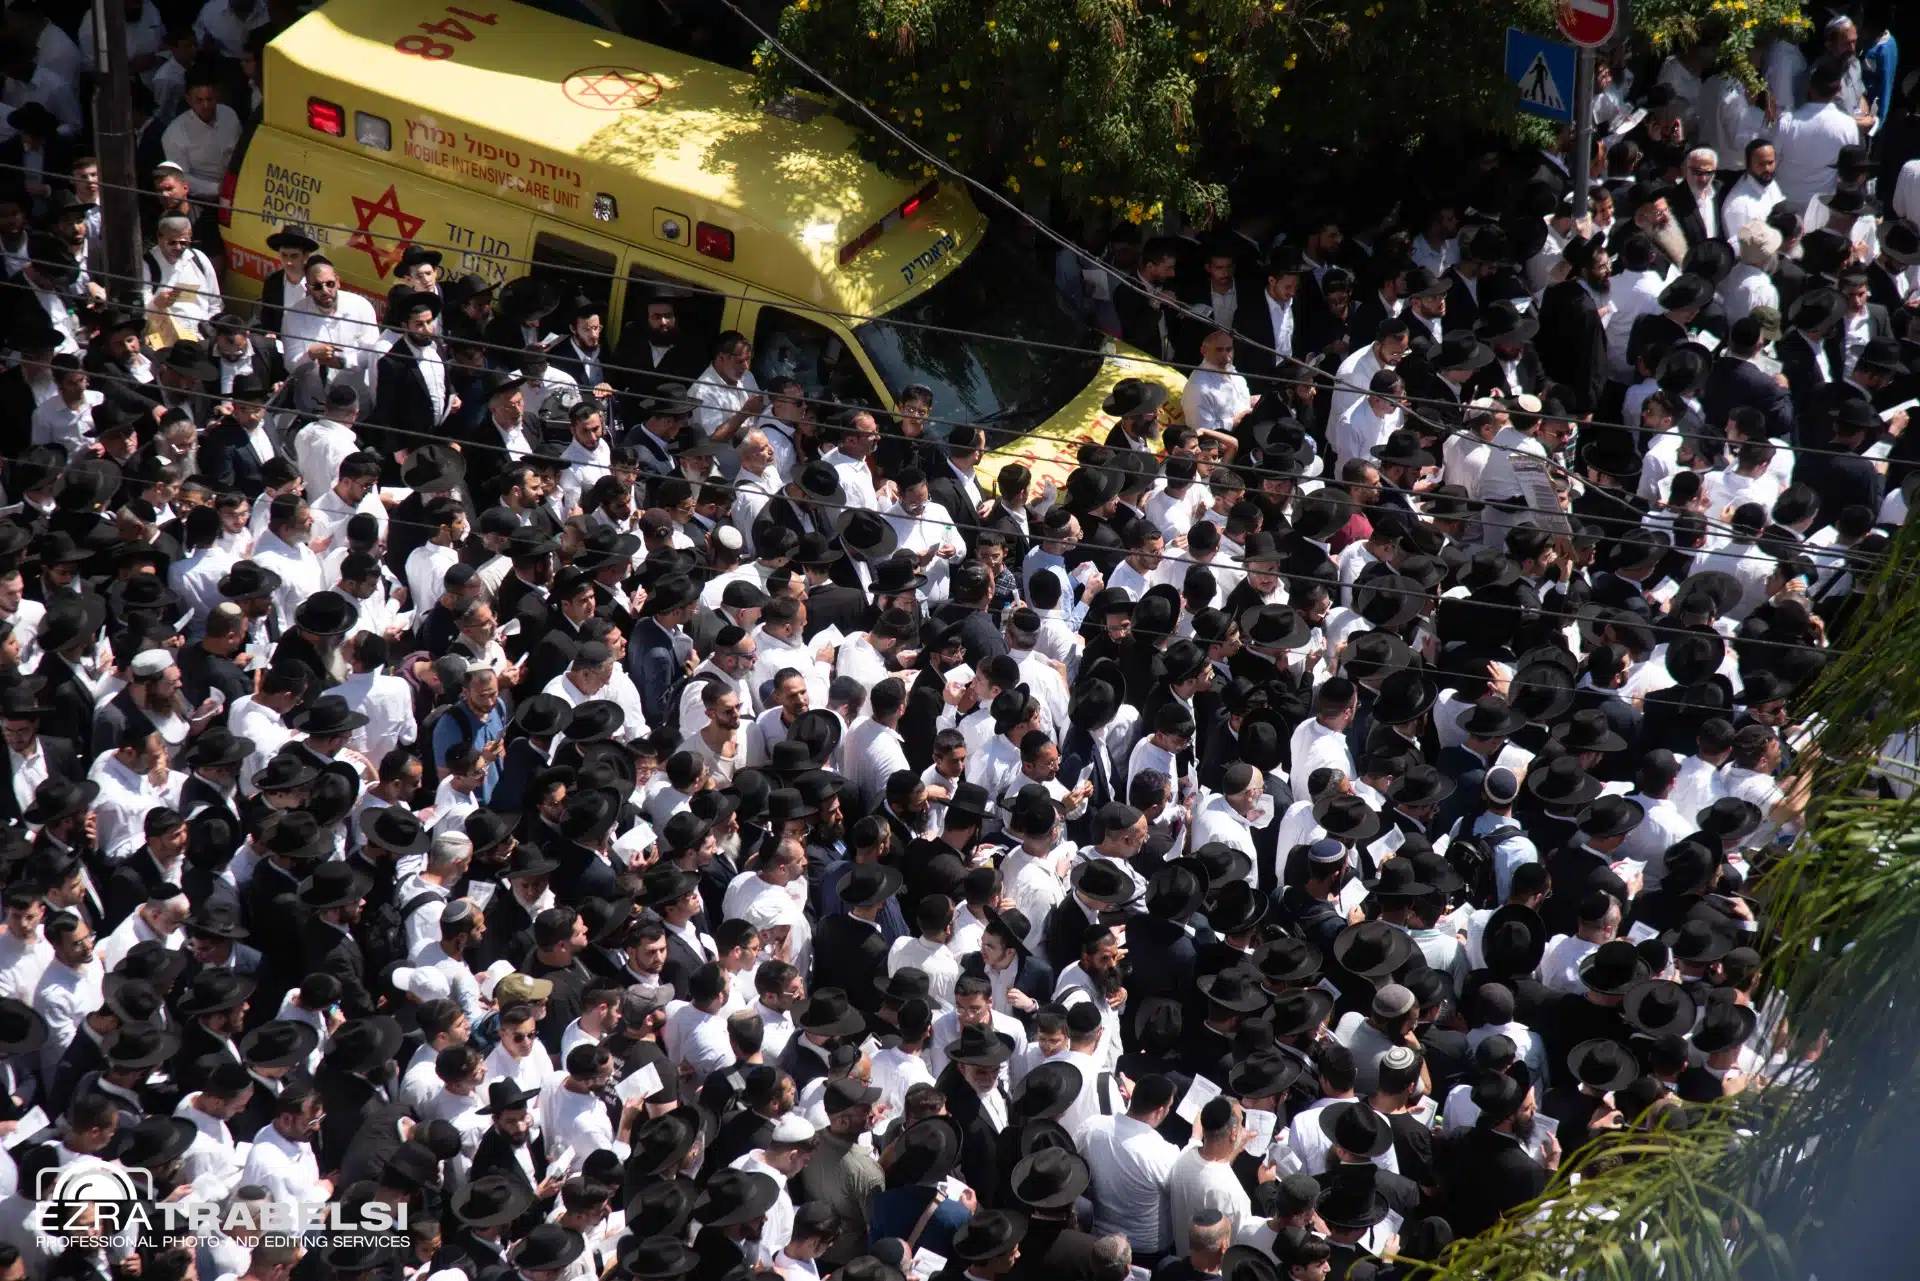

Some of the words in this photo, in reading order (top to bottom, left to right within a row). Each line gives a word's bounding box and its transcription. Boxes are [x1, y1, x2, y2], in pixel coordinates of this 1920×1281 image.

[394, 6, 499, 61] 148
[404, 118, 456, 148] נמרץ
[463, 132, 521, 169] טיפול
[266, 163, 322, 194] MAGEN
[404, 140, 449, 169] MOBILE
[452, 155, 514, 188] INTENSIVE
[517, 176, 550, 201] CARE
[553, 187, 581, 210] UNIT
[529, 157, 581, 188] ניידת
[264, 179, 310, 206] DAVID
[261, 208, 278, 226] IN
[263, 195, 310, 222] ADOM
[445, 222, 475, 248] דוד
[480, 235, 510, 257] מגן
[462, 251, 508, 281] אדום
[900, 235, 955, 286] פראמדיק
